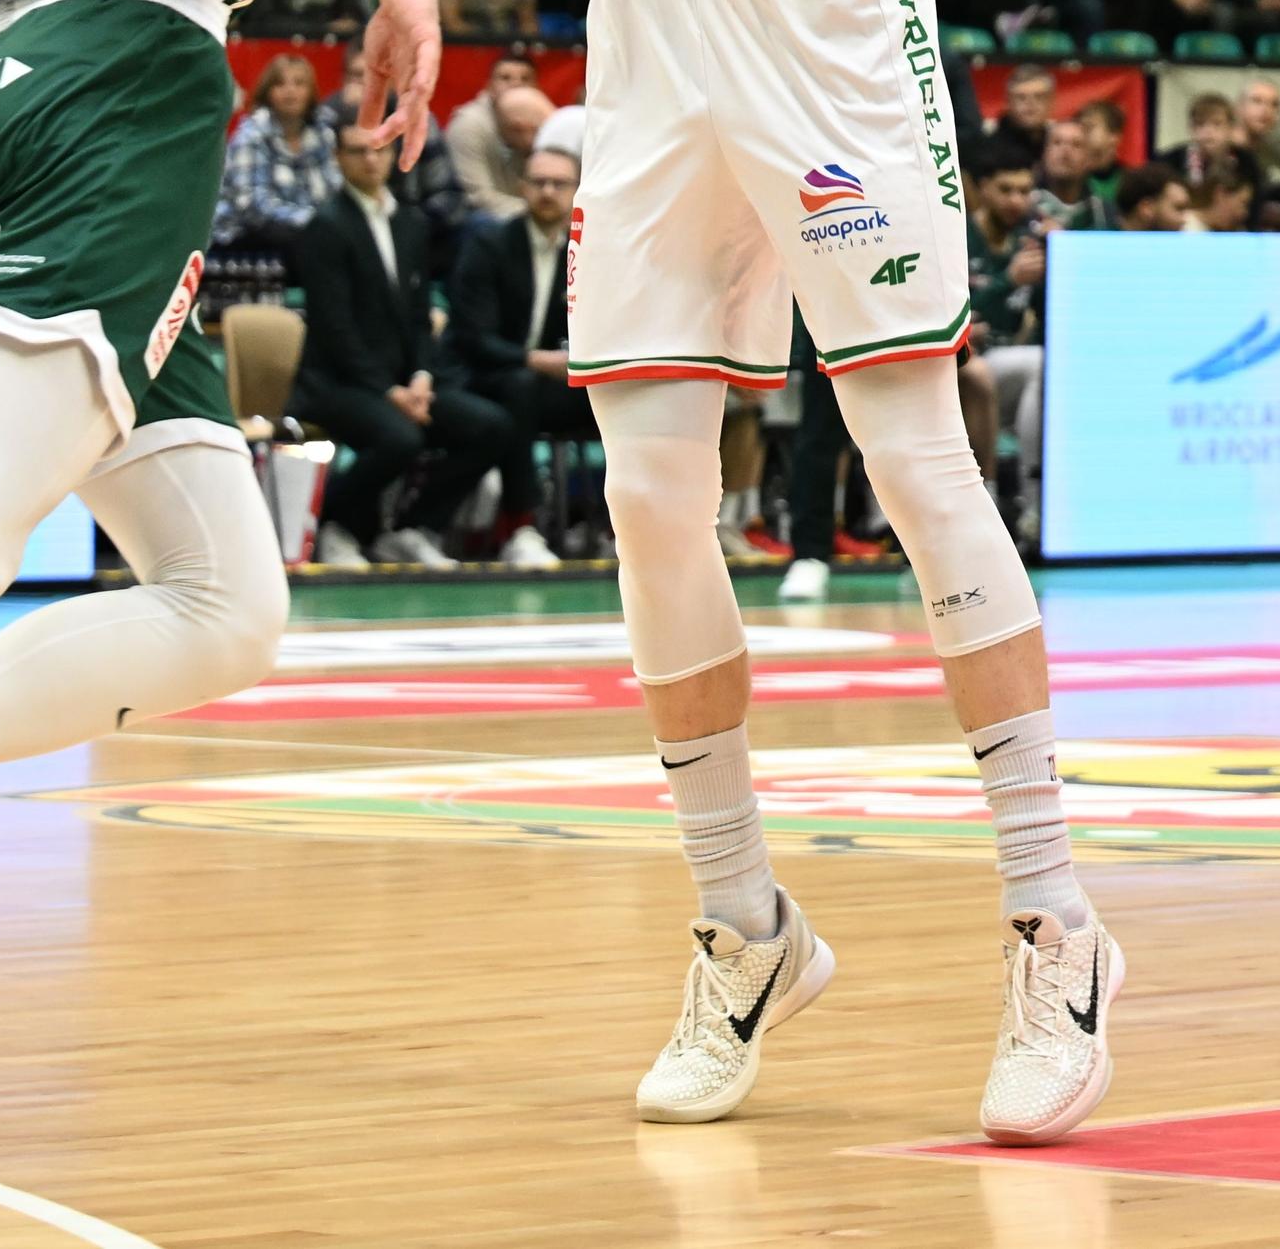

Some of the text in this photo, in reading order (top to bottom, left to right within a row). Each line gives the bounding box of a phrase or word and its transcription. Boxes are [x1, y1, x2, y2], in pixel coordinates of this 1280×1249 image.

[800, 210, 892, 245] aquapark
[869, 252, 921, 286] 4F
[931, 587, 982, 609] HEX
